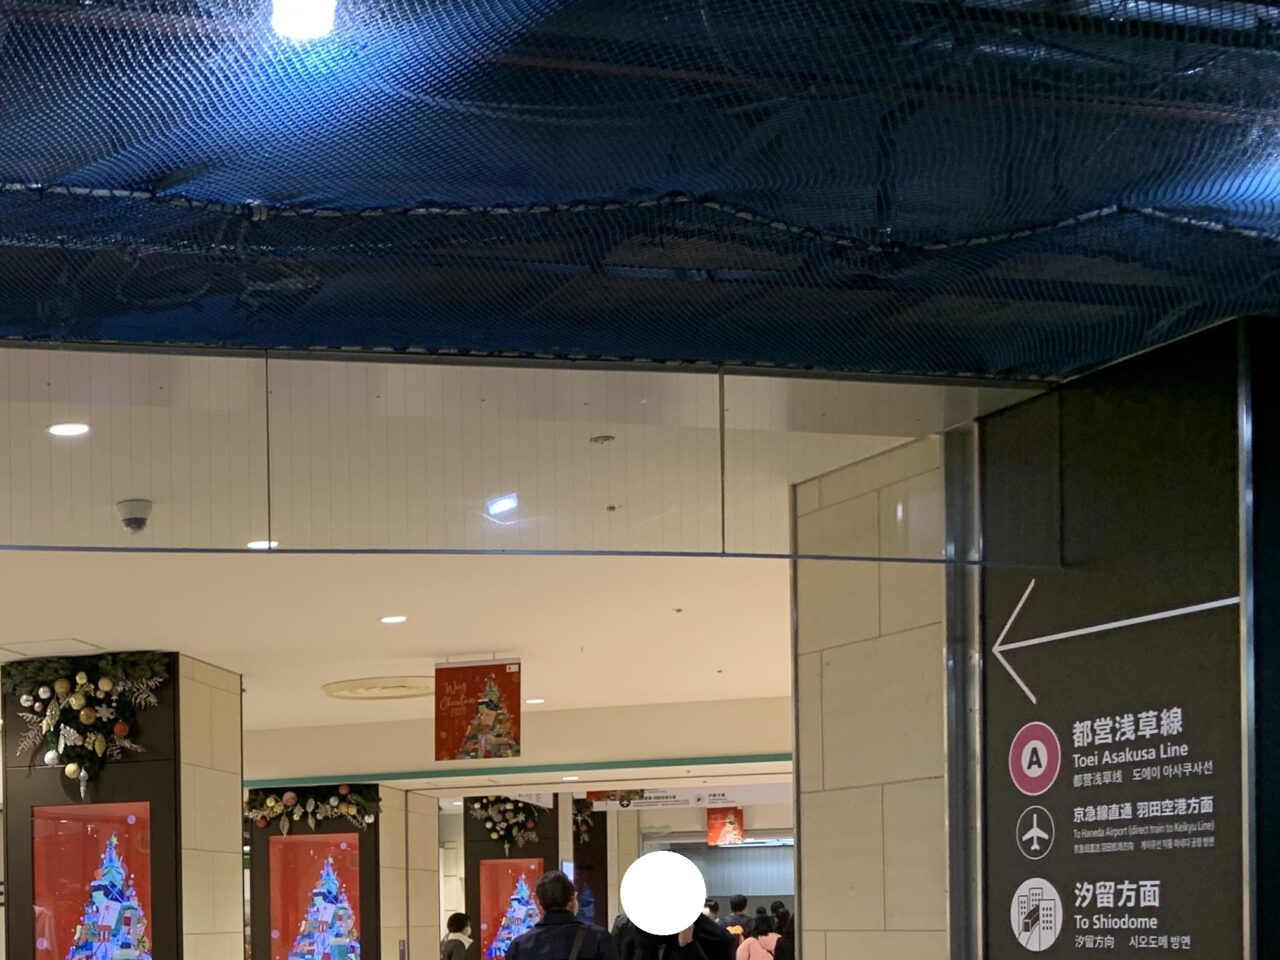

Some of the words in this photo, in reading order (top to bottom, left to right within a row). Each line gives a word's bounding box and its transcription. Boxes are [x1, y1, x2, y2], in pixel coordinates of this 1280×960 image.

[1072, 706, 1183, 748] 都営浅草線
[1027, 747, 1043, 770] A
[1072, 751, 1099, 768] Toei
[1101, 747, 1157, 765] Asakusa
[1159, 742, 1189, 759] Line
[1132, 765, 1161, 781] 도에이
[1162, 760, 1214, 778] 아사쿠사선
[1073, 802, 1133, 823] 京急線直通
[1136, 796, 1214, 818] 羽田空港方面
[1105, 825, 1128, 838] Airport
[1074, 880, 1161, 909] 汐留方面
[1074, 914, 1090, 930] To
[1092, 913, 1159, 930] Shiodome
[1074, 935, 1115, 949] 汐留方向
[1129, 935, 1169, 949] 시오도메
